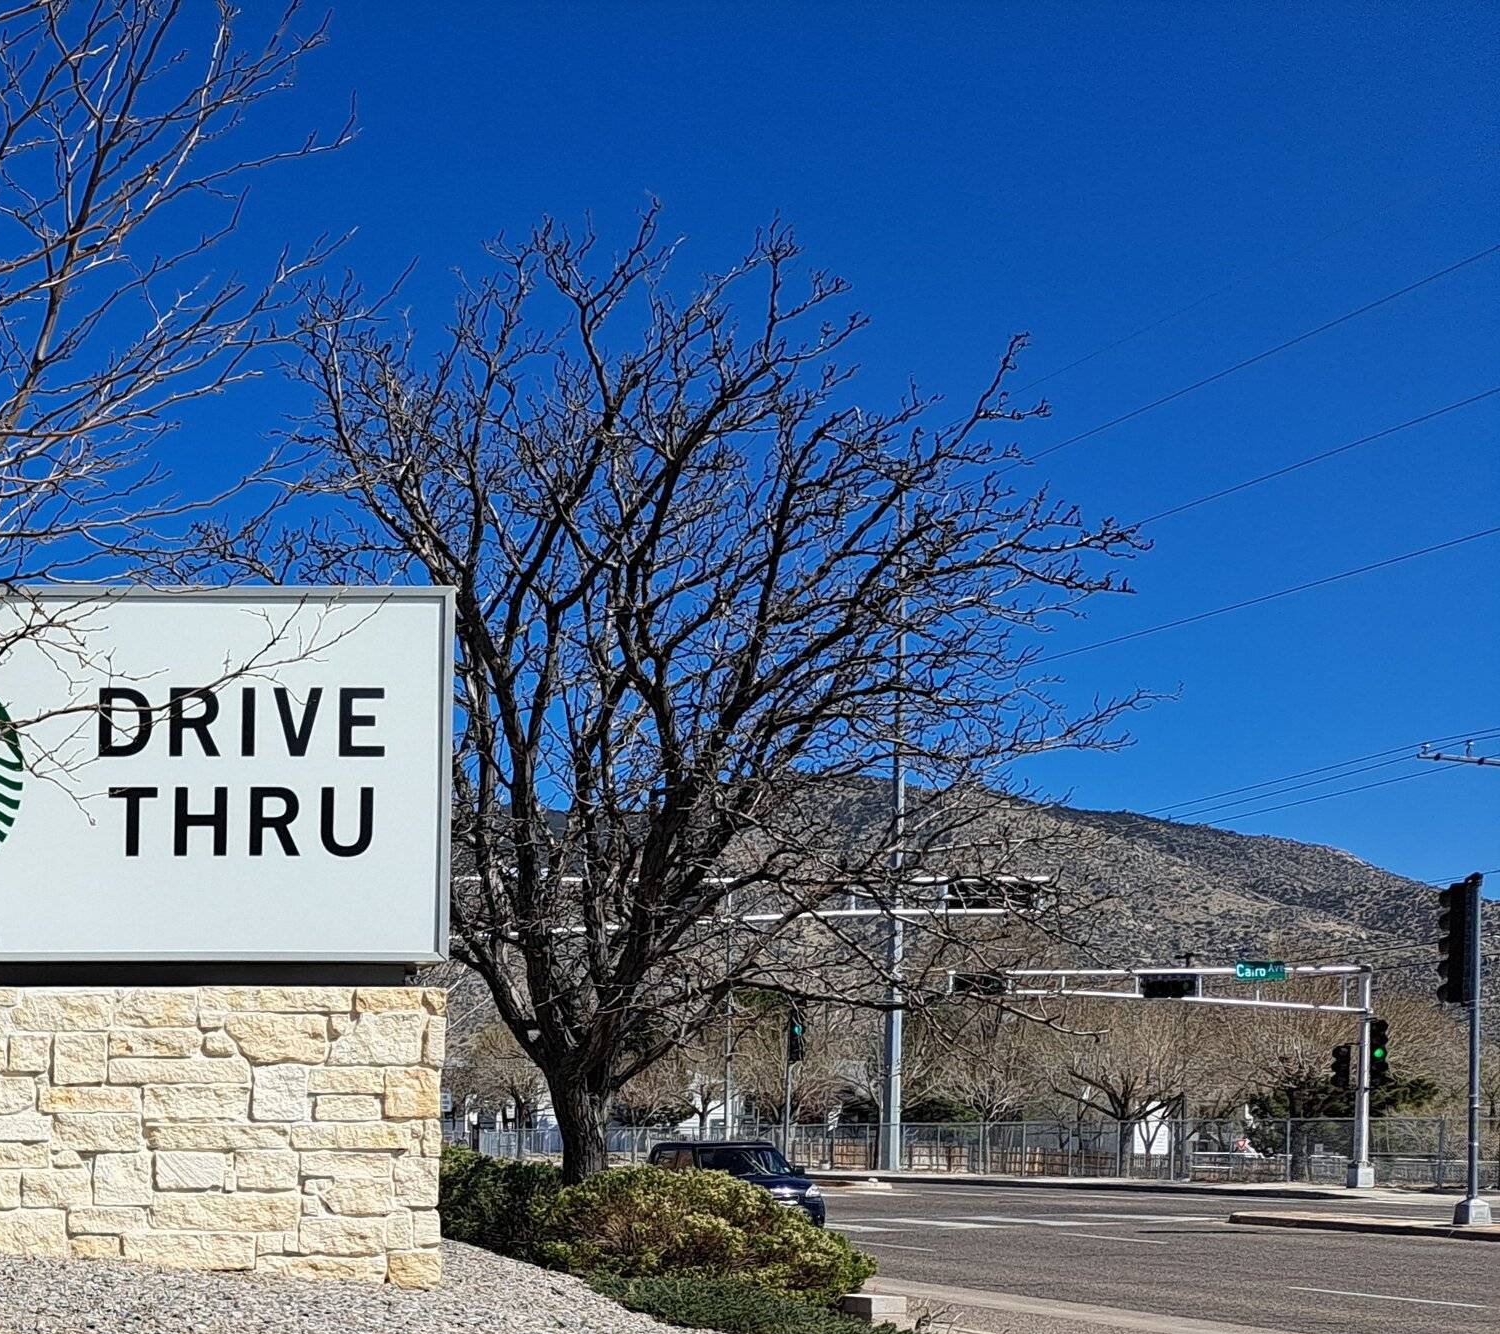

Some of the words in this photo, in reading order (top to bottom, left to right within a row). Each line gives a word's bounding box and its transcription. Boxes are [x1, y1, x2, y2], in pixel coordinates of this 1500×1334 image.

[99, 687, 386, 758] DRIVE
[108, 786, 375, 858] THRU
[1236, 963, 1267, 978] Cairo
